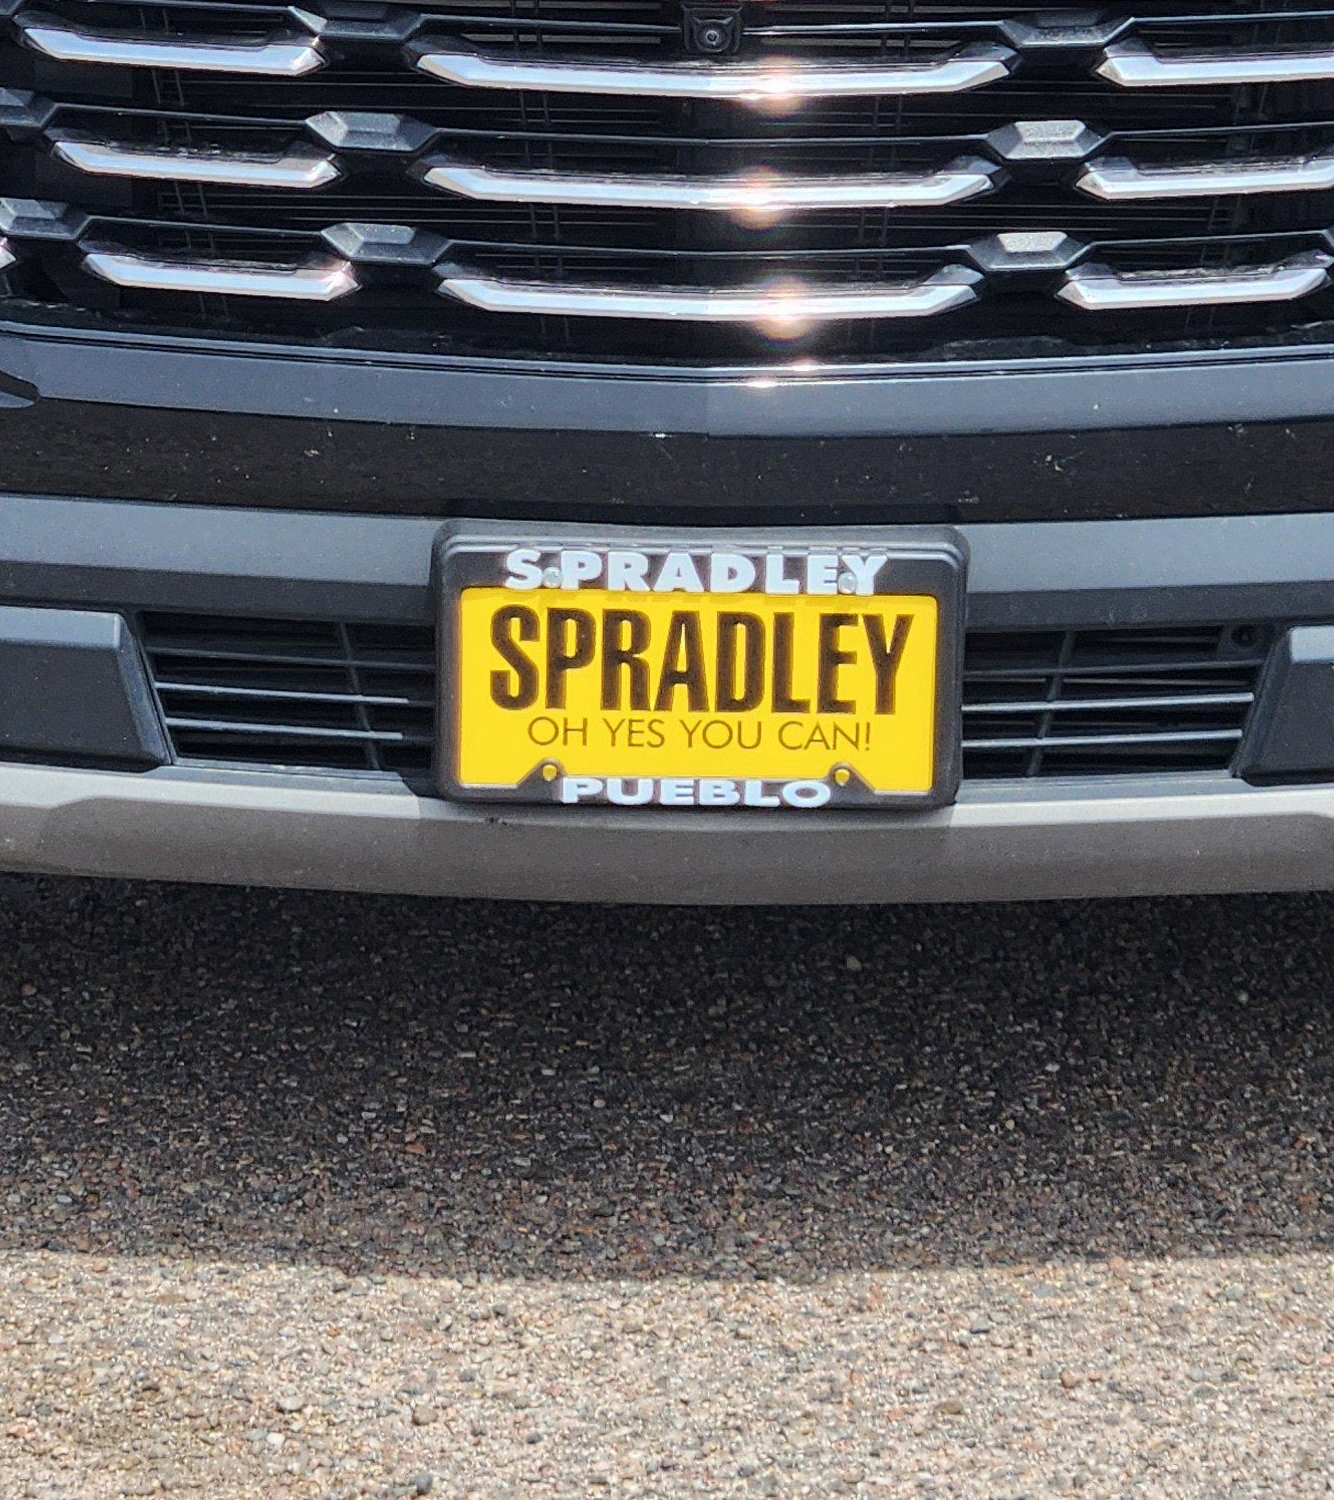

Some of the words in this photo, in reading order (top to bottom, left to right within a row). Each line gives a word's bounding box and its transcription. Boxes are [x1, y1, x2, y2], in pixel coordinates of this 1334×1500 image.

[505, 548, 888, 596] SPRADLEY
[490, 604, 915, 716] SPRADLEY
[528, 716, 588, 747] OH
[603, 718, 666, 749] YES
[679, 719, 763, 751] YOU
[777, 721, 872, 752] CAN!
[561, 777, 832, 808] PUEBLO
